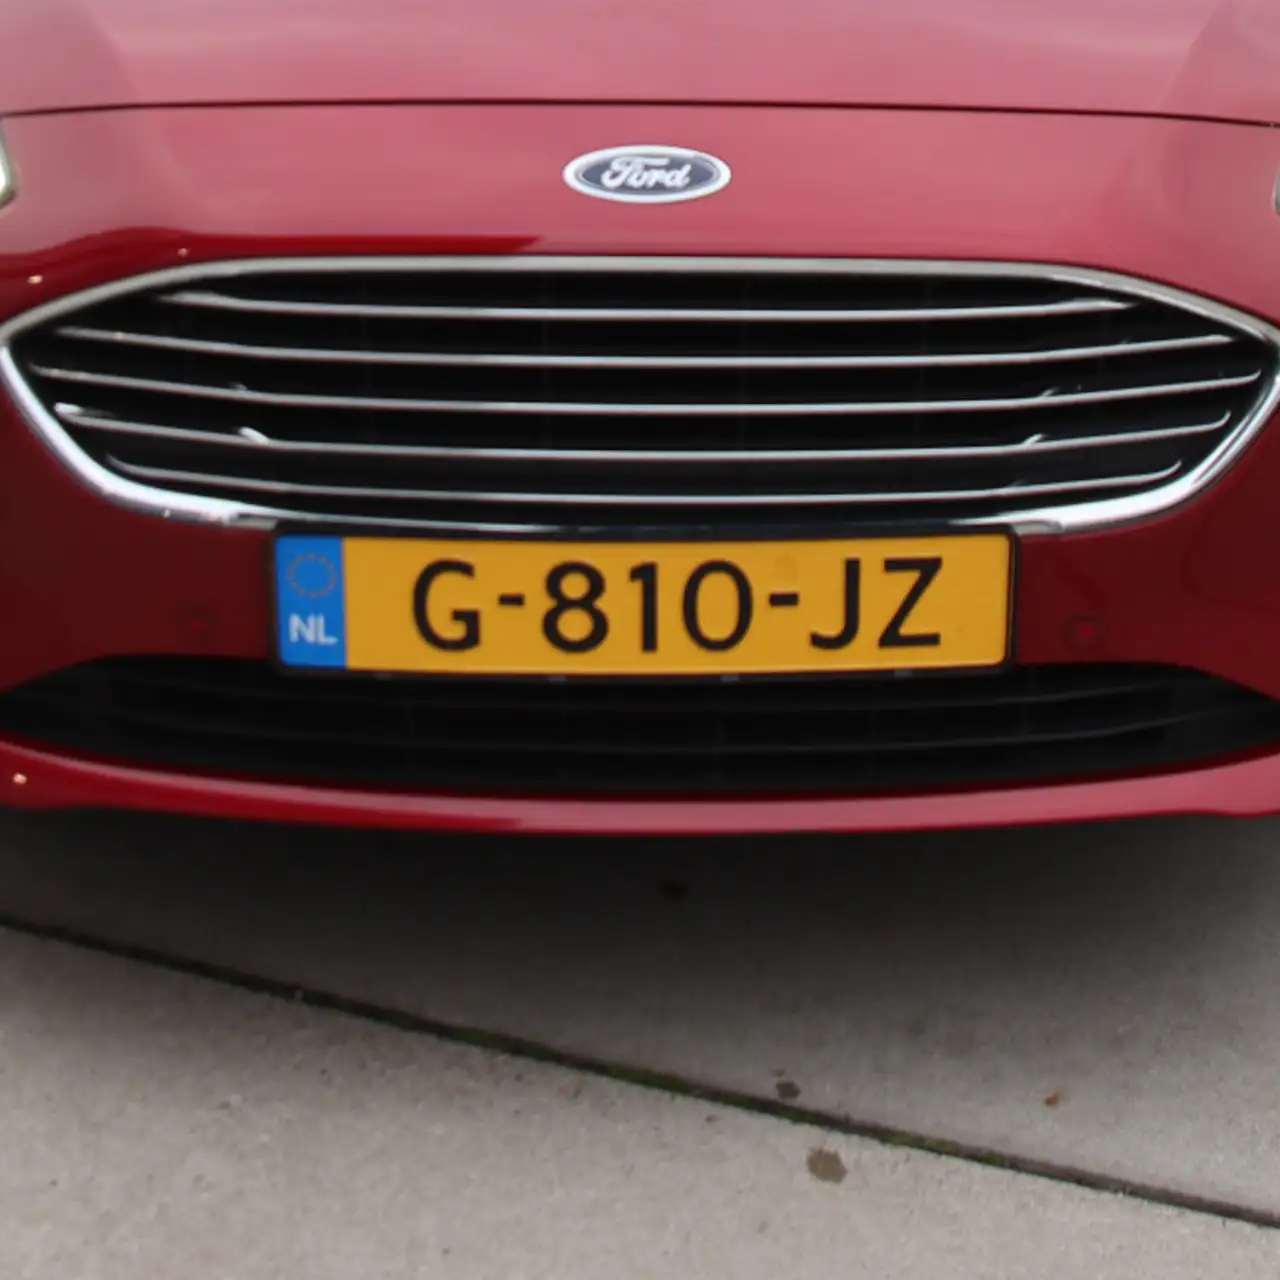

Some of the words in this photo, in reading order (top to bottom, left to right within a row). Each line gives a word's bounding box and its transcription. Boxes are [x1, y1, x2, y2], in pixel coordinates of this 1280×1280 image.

[600, 156, 692, 189] Ford
[411, 556, 944, 654] G-810-JZ
[288, 613, 338, 646] NL
